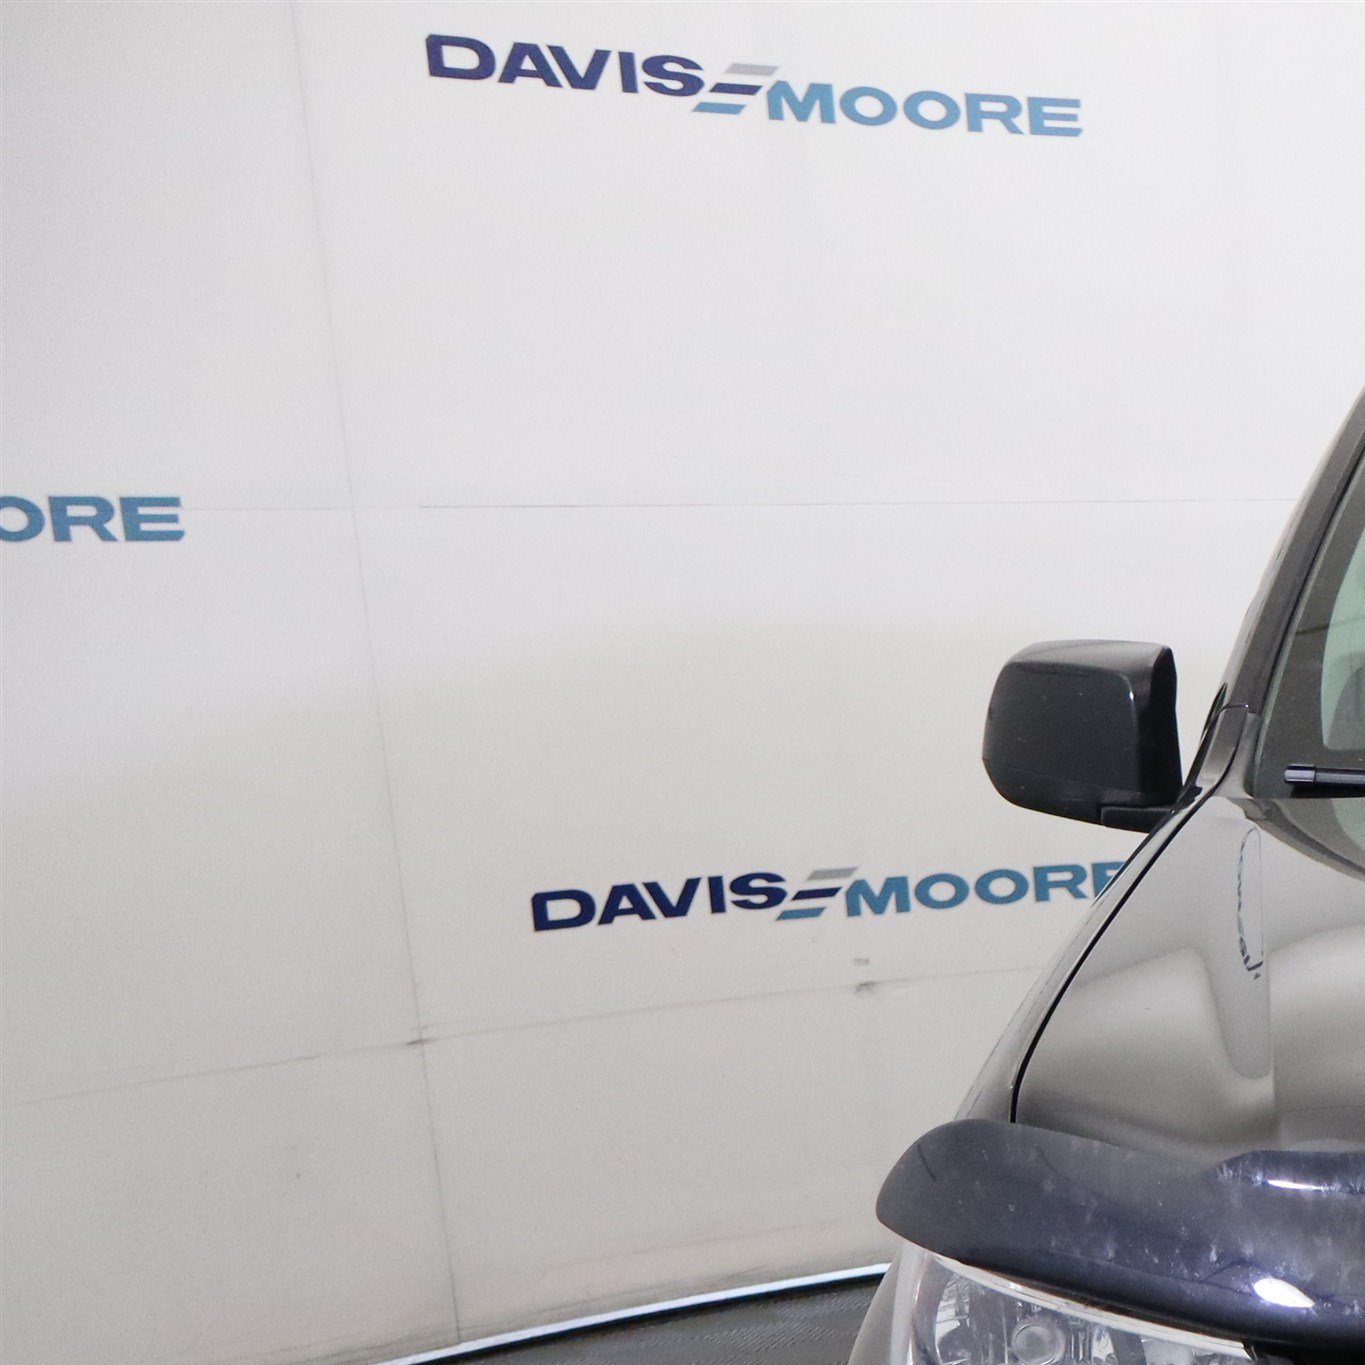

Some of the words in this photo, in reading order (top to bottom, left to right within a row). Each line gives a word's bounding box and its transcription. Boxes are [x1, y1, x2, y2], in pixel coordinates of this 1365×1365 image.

[425, 33, 706, 98] DAVIS
[766, 80, 1084, 138] MOORE
[531, 872, 788, 932] DAVIS
